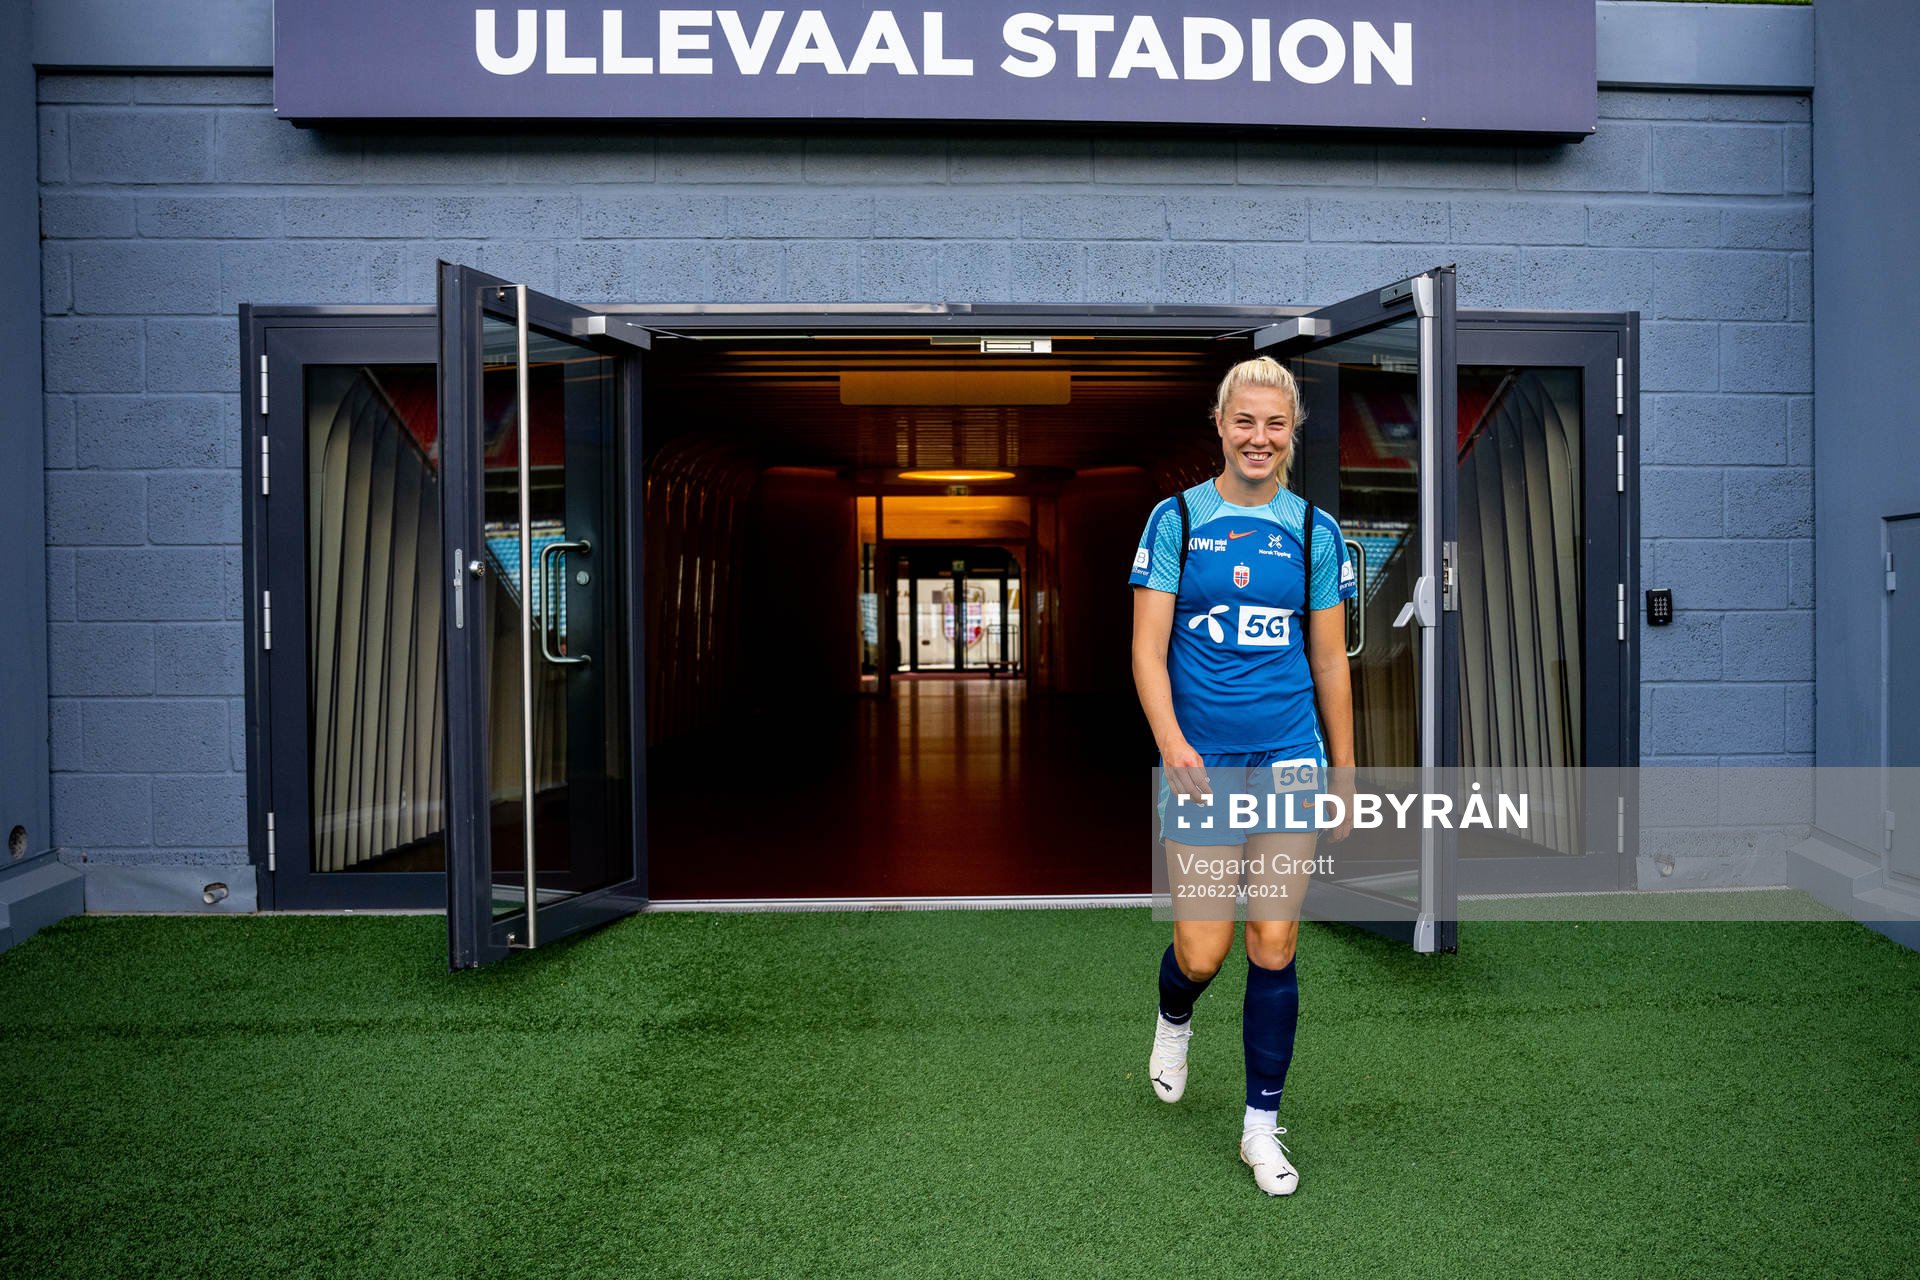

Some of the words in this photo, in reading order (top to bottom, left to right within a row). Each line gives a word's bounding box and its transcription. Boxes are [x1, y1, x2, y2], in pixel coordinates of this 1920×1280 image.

[475, 9, 974, 76] ULLEVAAL
[999, 12, 1413, 86] STADION
[1189, 537, 1214, 551] KIWI
[1274, 550, 1292, 559] Tipping
[1244, 614, 1285, 639] 5G
[1279, 764, 1314, 787] 5G
